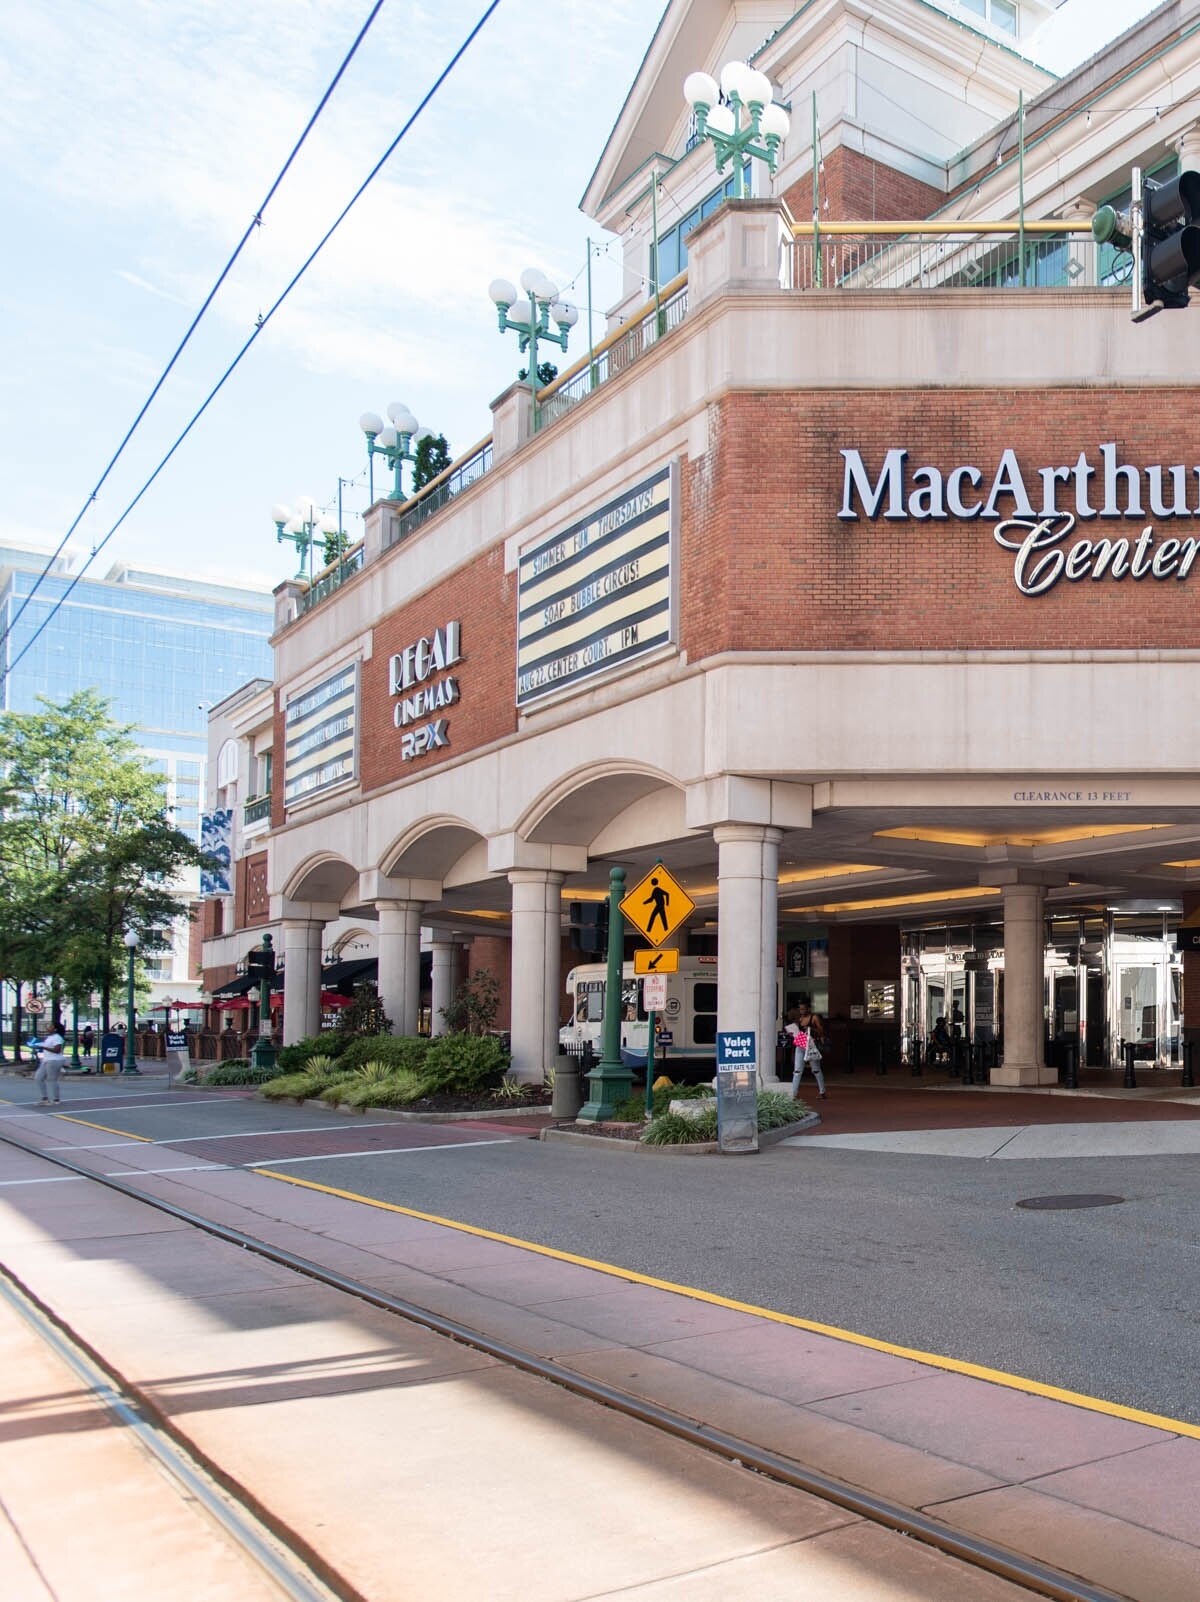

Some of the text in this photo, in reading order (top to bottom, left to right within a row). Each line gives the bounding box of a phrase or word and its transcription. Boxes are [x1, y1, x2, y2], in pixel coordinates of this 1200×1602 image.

[533, 488, 654, 575] SUMMER FUN THURSDAYS!
[544, 560, 640, 626] SOAP BUBBLE CIRCUS!
[389, 620, 462, 697] REGAL
[520, 674, 535, 693] AUG
[548, 653, 579, 680] CENTER
[394, 676, 459, 728] CINEMAS
[401, 719, 449, 761] RPX
[1013, 791, 1132, 801] CLEARANCE 13 FEET
[723, 1037, 752, 1047] Valet
[725, 1047, 750, 1058] Park
